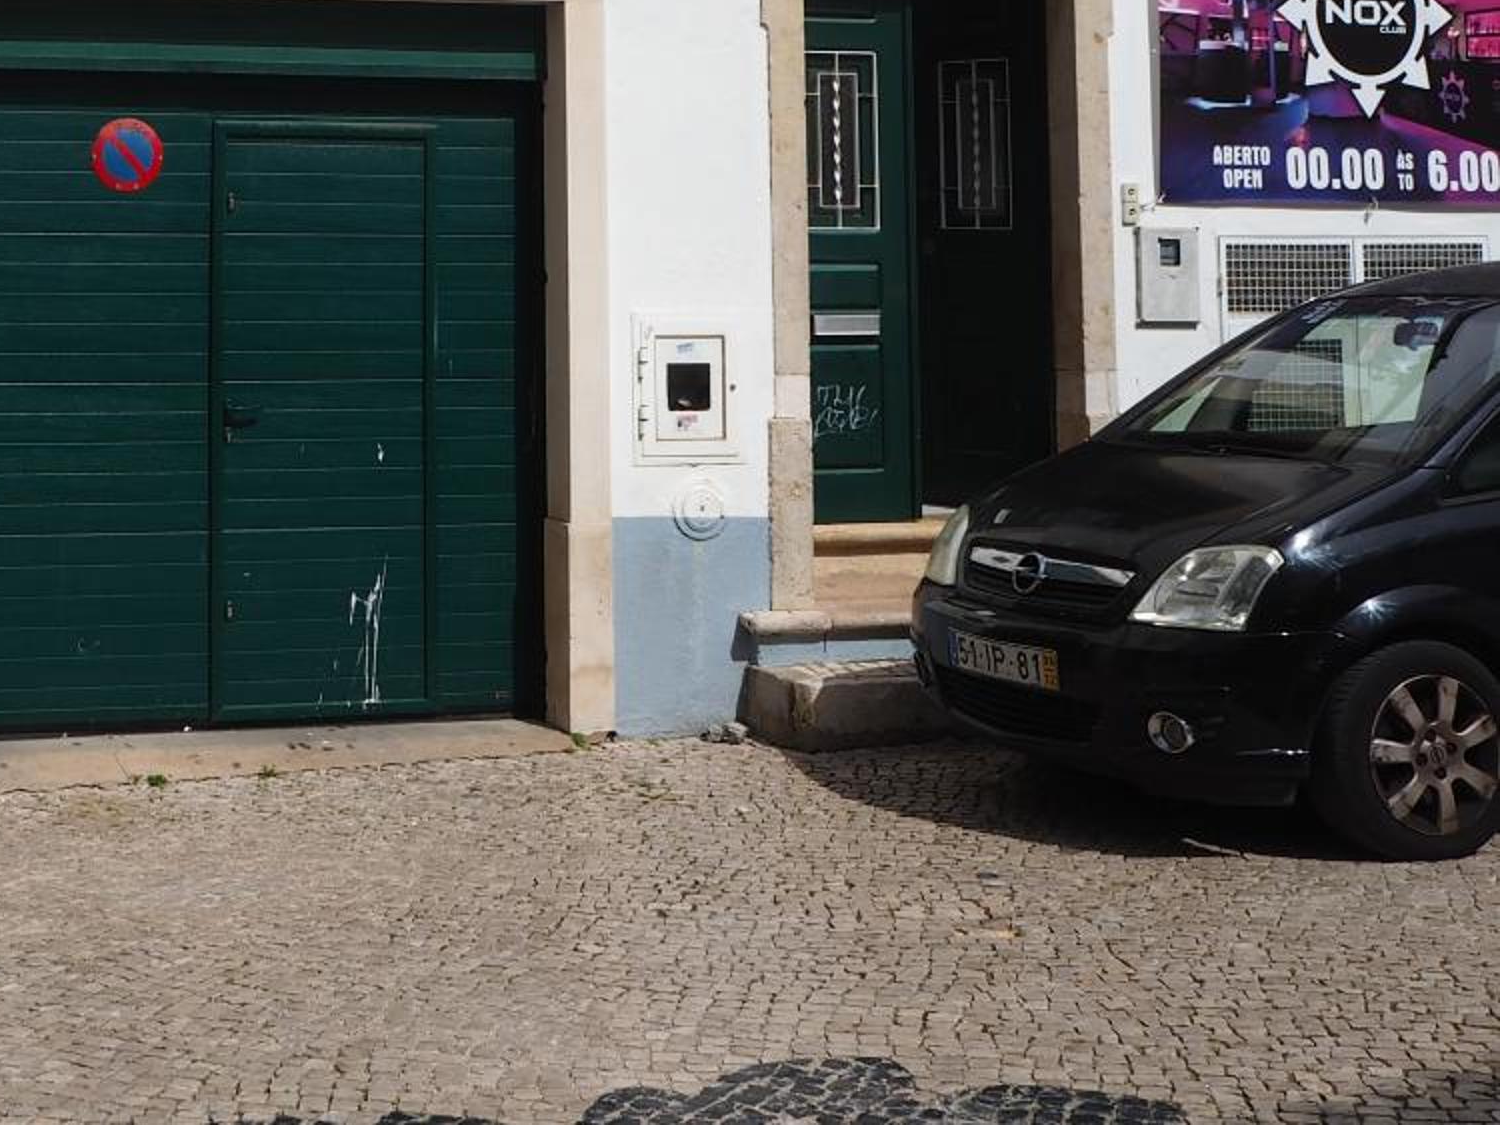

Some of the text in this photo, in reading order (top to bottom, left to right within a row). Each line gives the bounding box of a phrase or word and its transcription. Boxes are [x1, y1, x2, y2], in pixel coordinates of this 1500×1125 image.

[1213, 144, 1271, 167] ABERTO
[1285, 146, 1384, 190] 00.00
[1427, 149, 1500, 192] 6.00
[1222, 169, 1415, 191] OPEN TO
